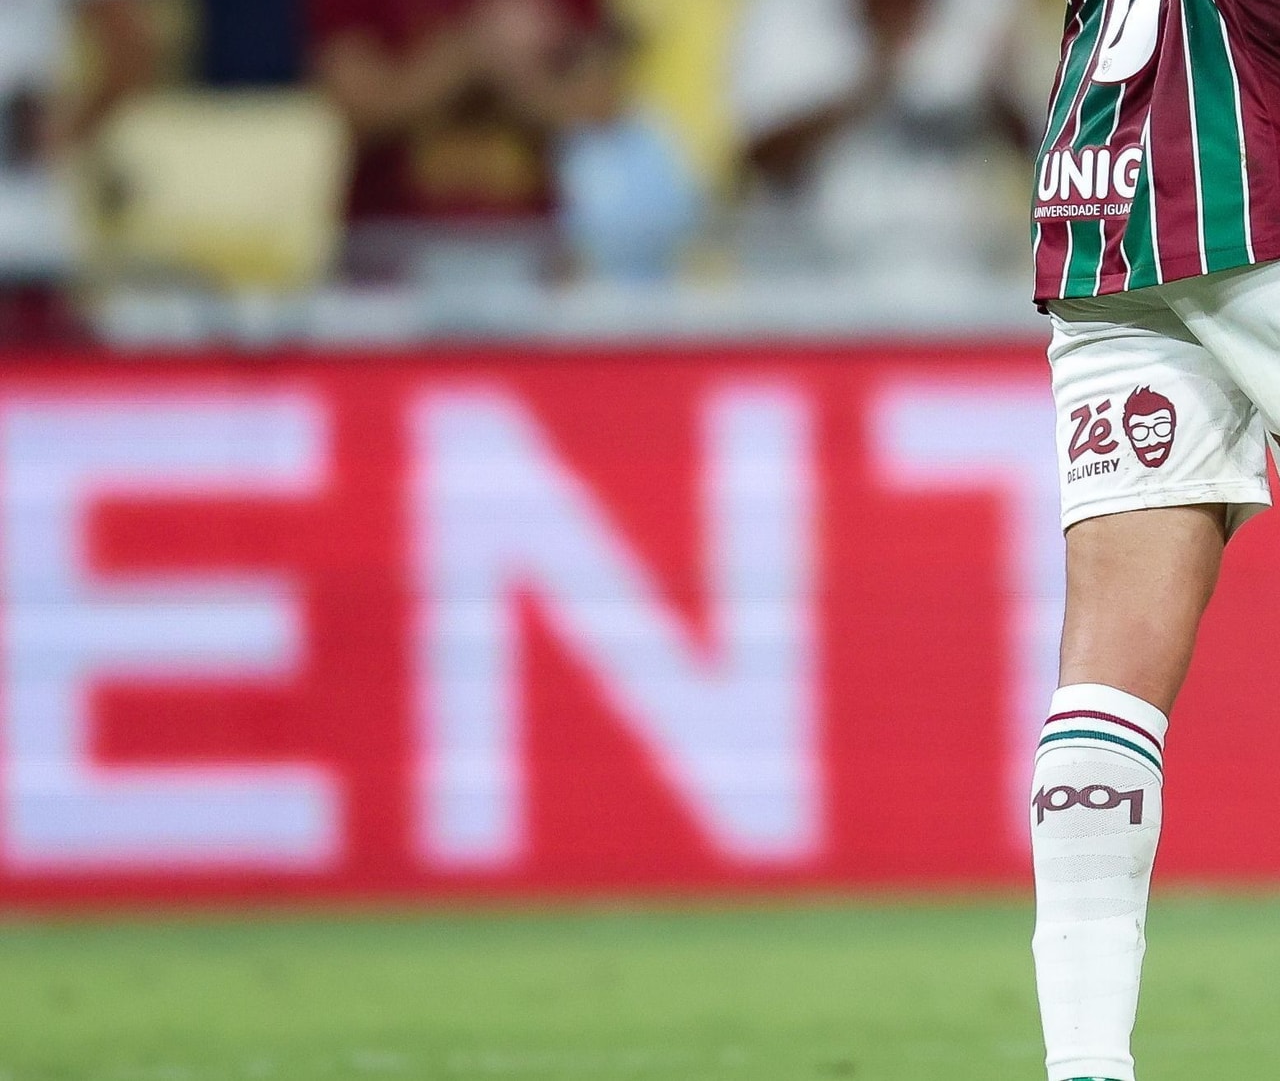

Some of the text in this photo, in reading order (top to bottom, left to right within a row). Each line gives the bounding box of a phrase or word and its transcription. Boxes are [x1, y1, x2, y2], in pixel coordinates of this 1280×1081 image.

[1038, 147, 1143, 202] UNIG
[1034, 203, 1101, 219] UNIVERSIDADE
[1068, 398, 1120, 465] Zé
[1067, 457, 1120, 485] DELIVERY
[1032, 784, 1145, 826] 1001
